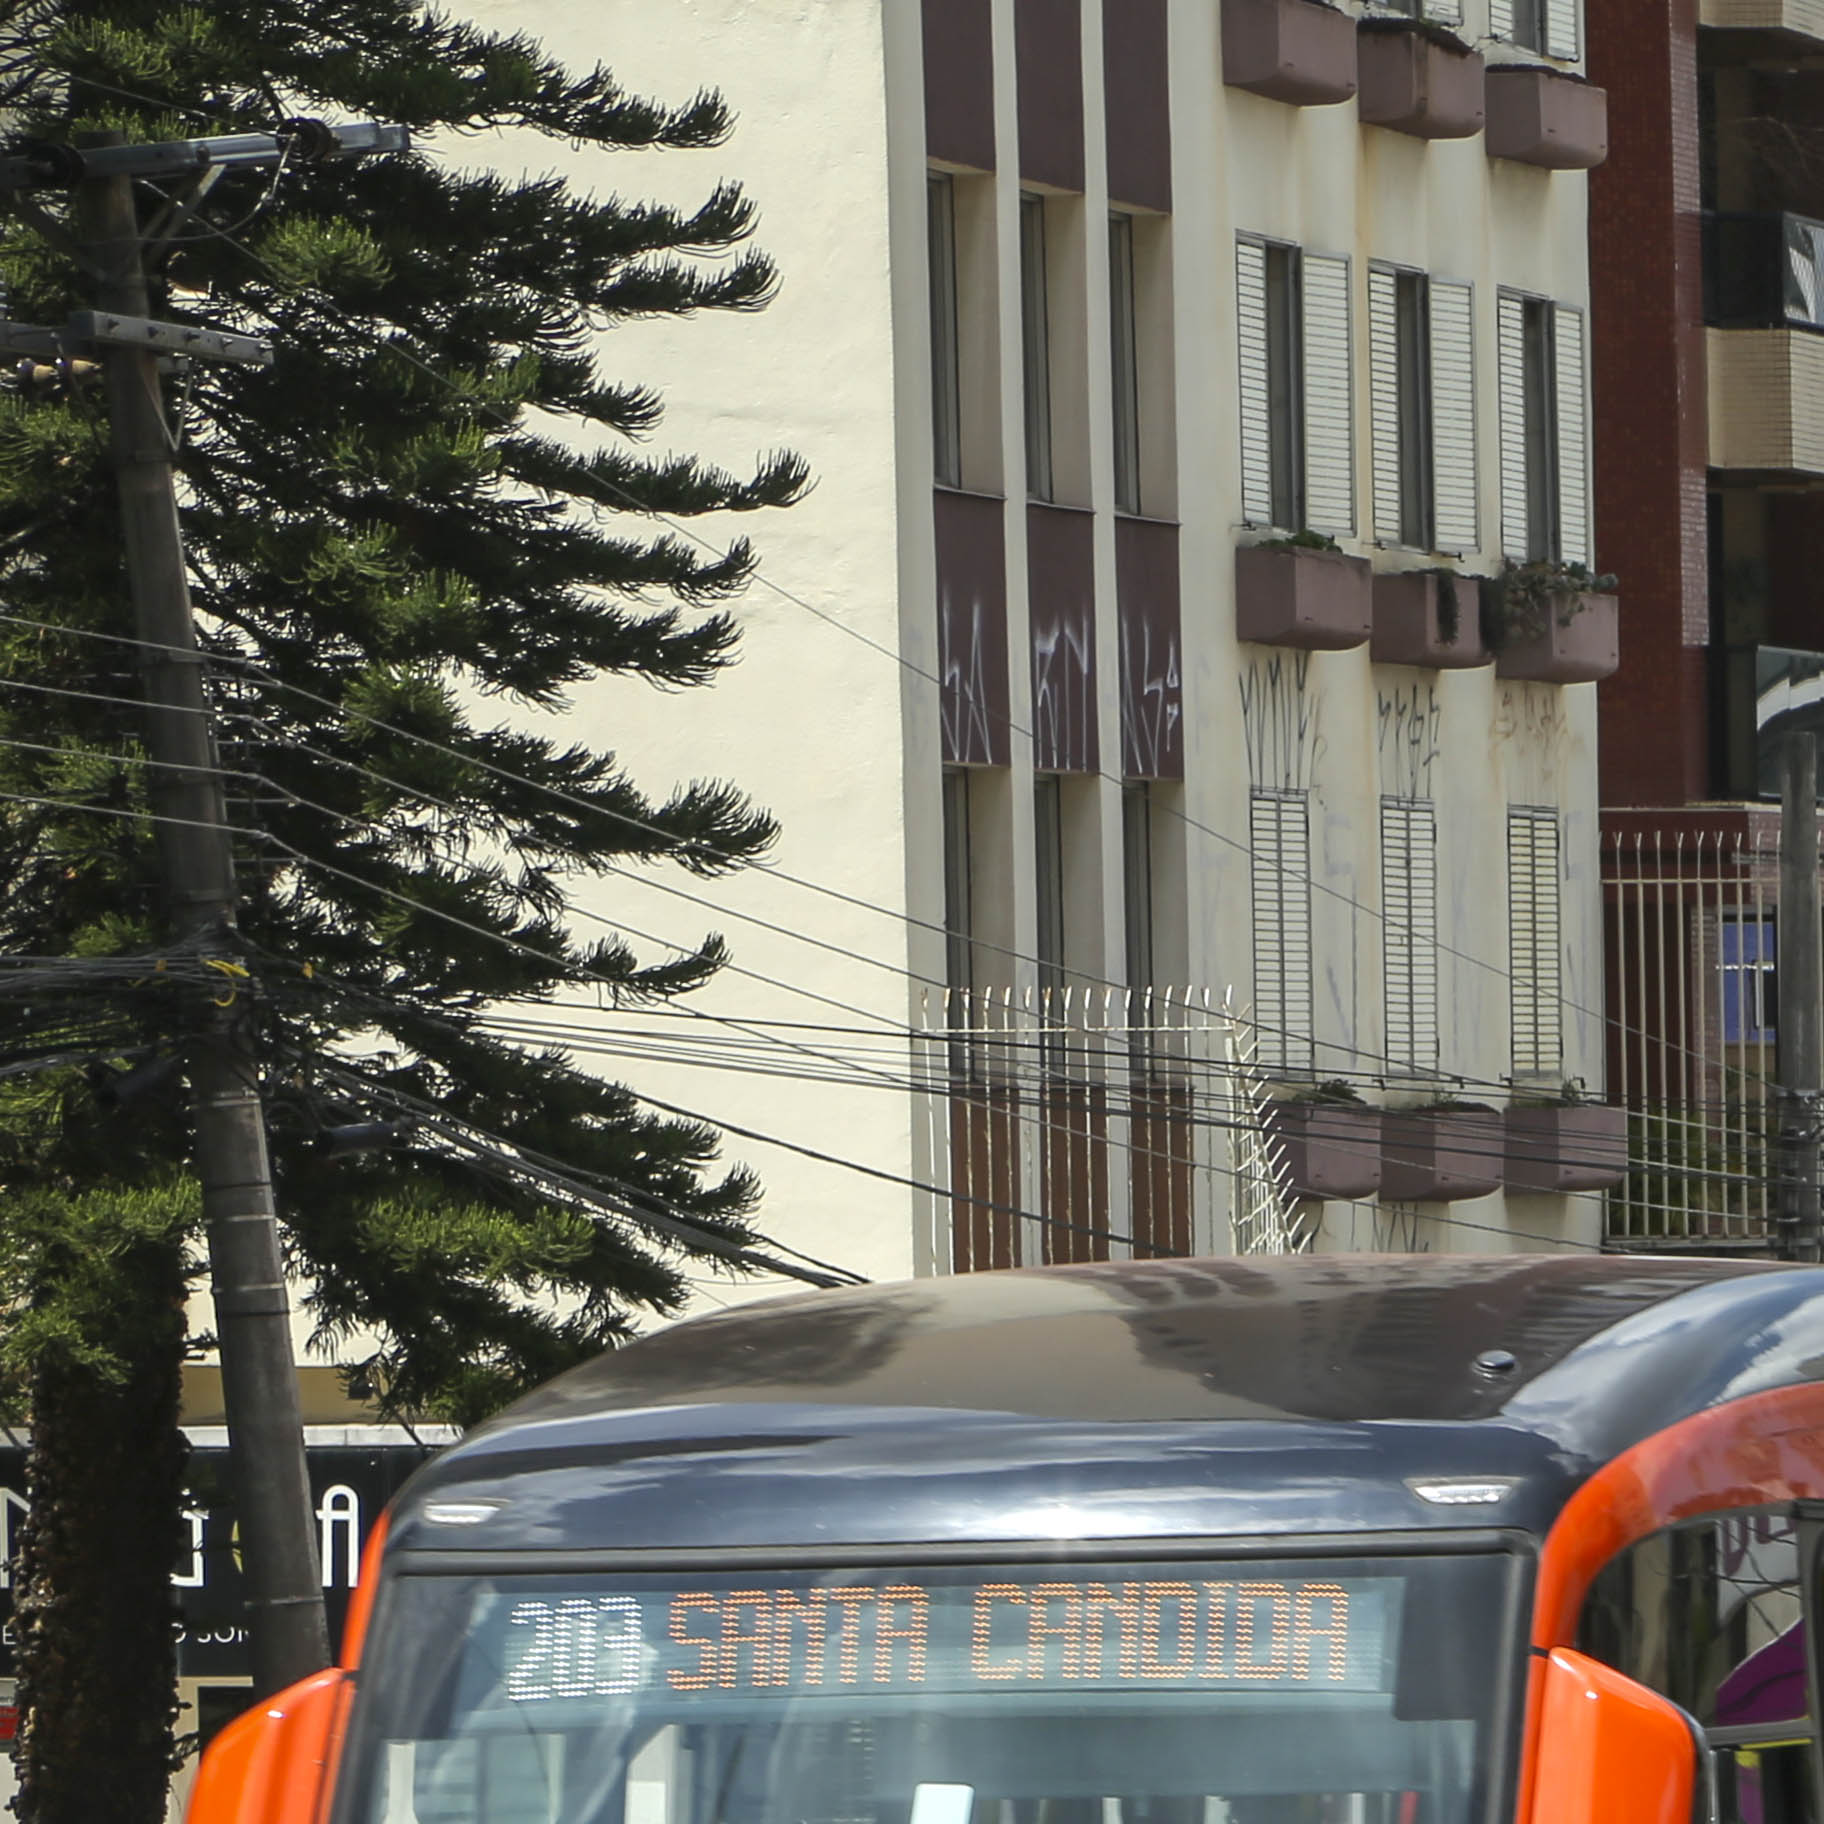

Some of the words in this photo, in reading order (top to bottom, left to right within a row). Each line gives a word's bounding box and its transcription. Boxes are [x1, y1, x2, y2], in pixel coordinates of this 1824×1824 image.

[507, 1596, 642, 1701] 203
[667, 1585, 930, 1691] SANTA
[972, 1581, 1350, 1681] CANDIDA
